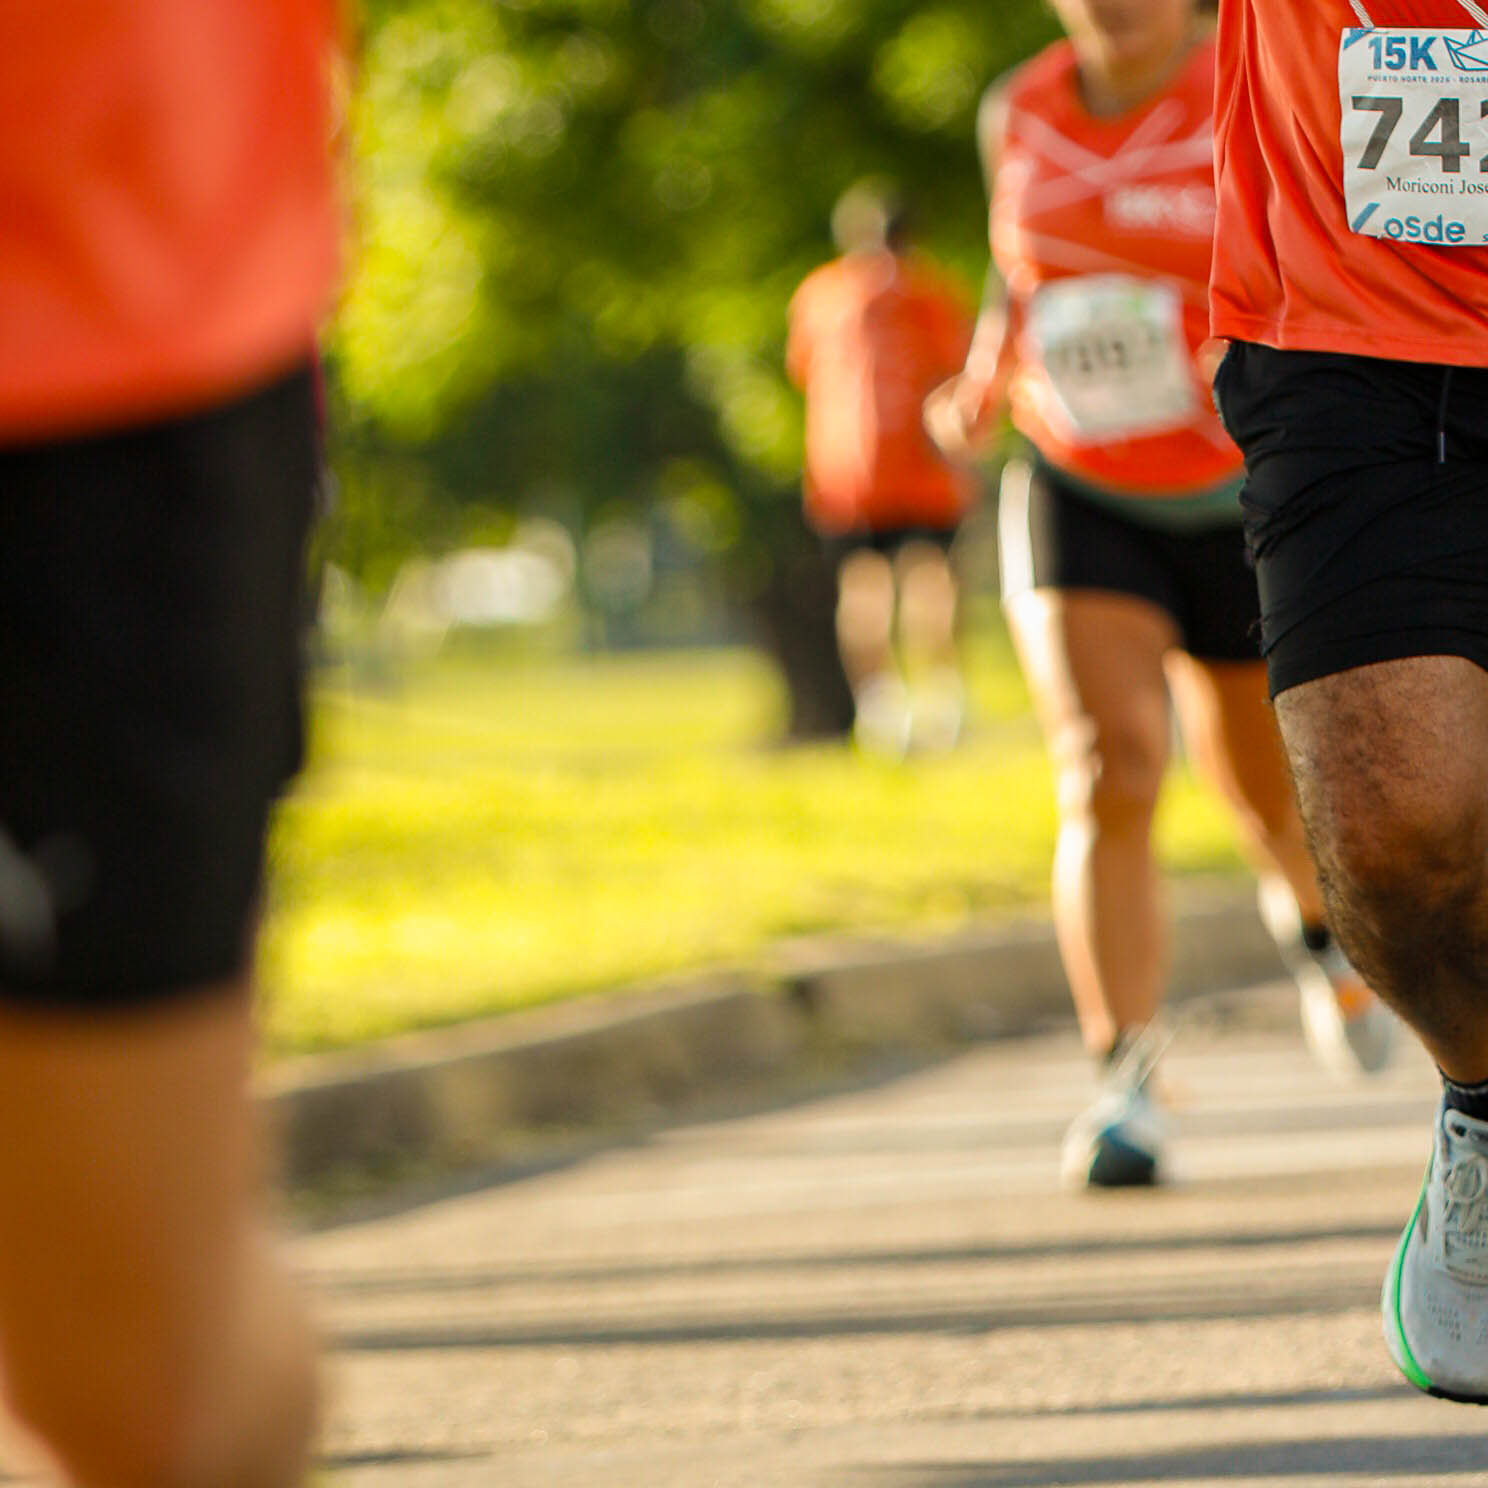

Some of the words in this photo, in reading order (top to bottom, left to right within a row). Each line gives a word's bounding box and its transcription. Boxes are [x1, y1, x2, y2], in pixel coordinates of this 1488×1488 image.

[1368, 35, 1438, 71] 15K
[1385, 176, 1454, 194] Moriconi
[1383, 214, 1466, 243] osde
